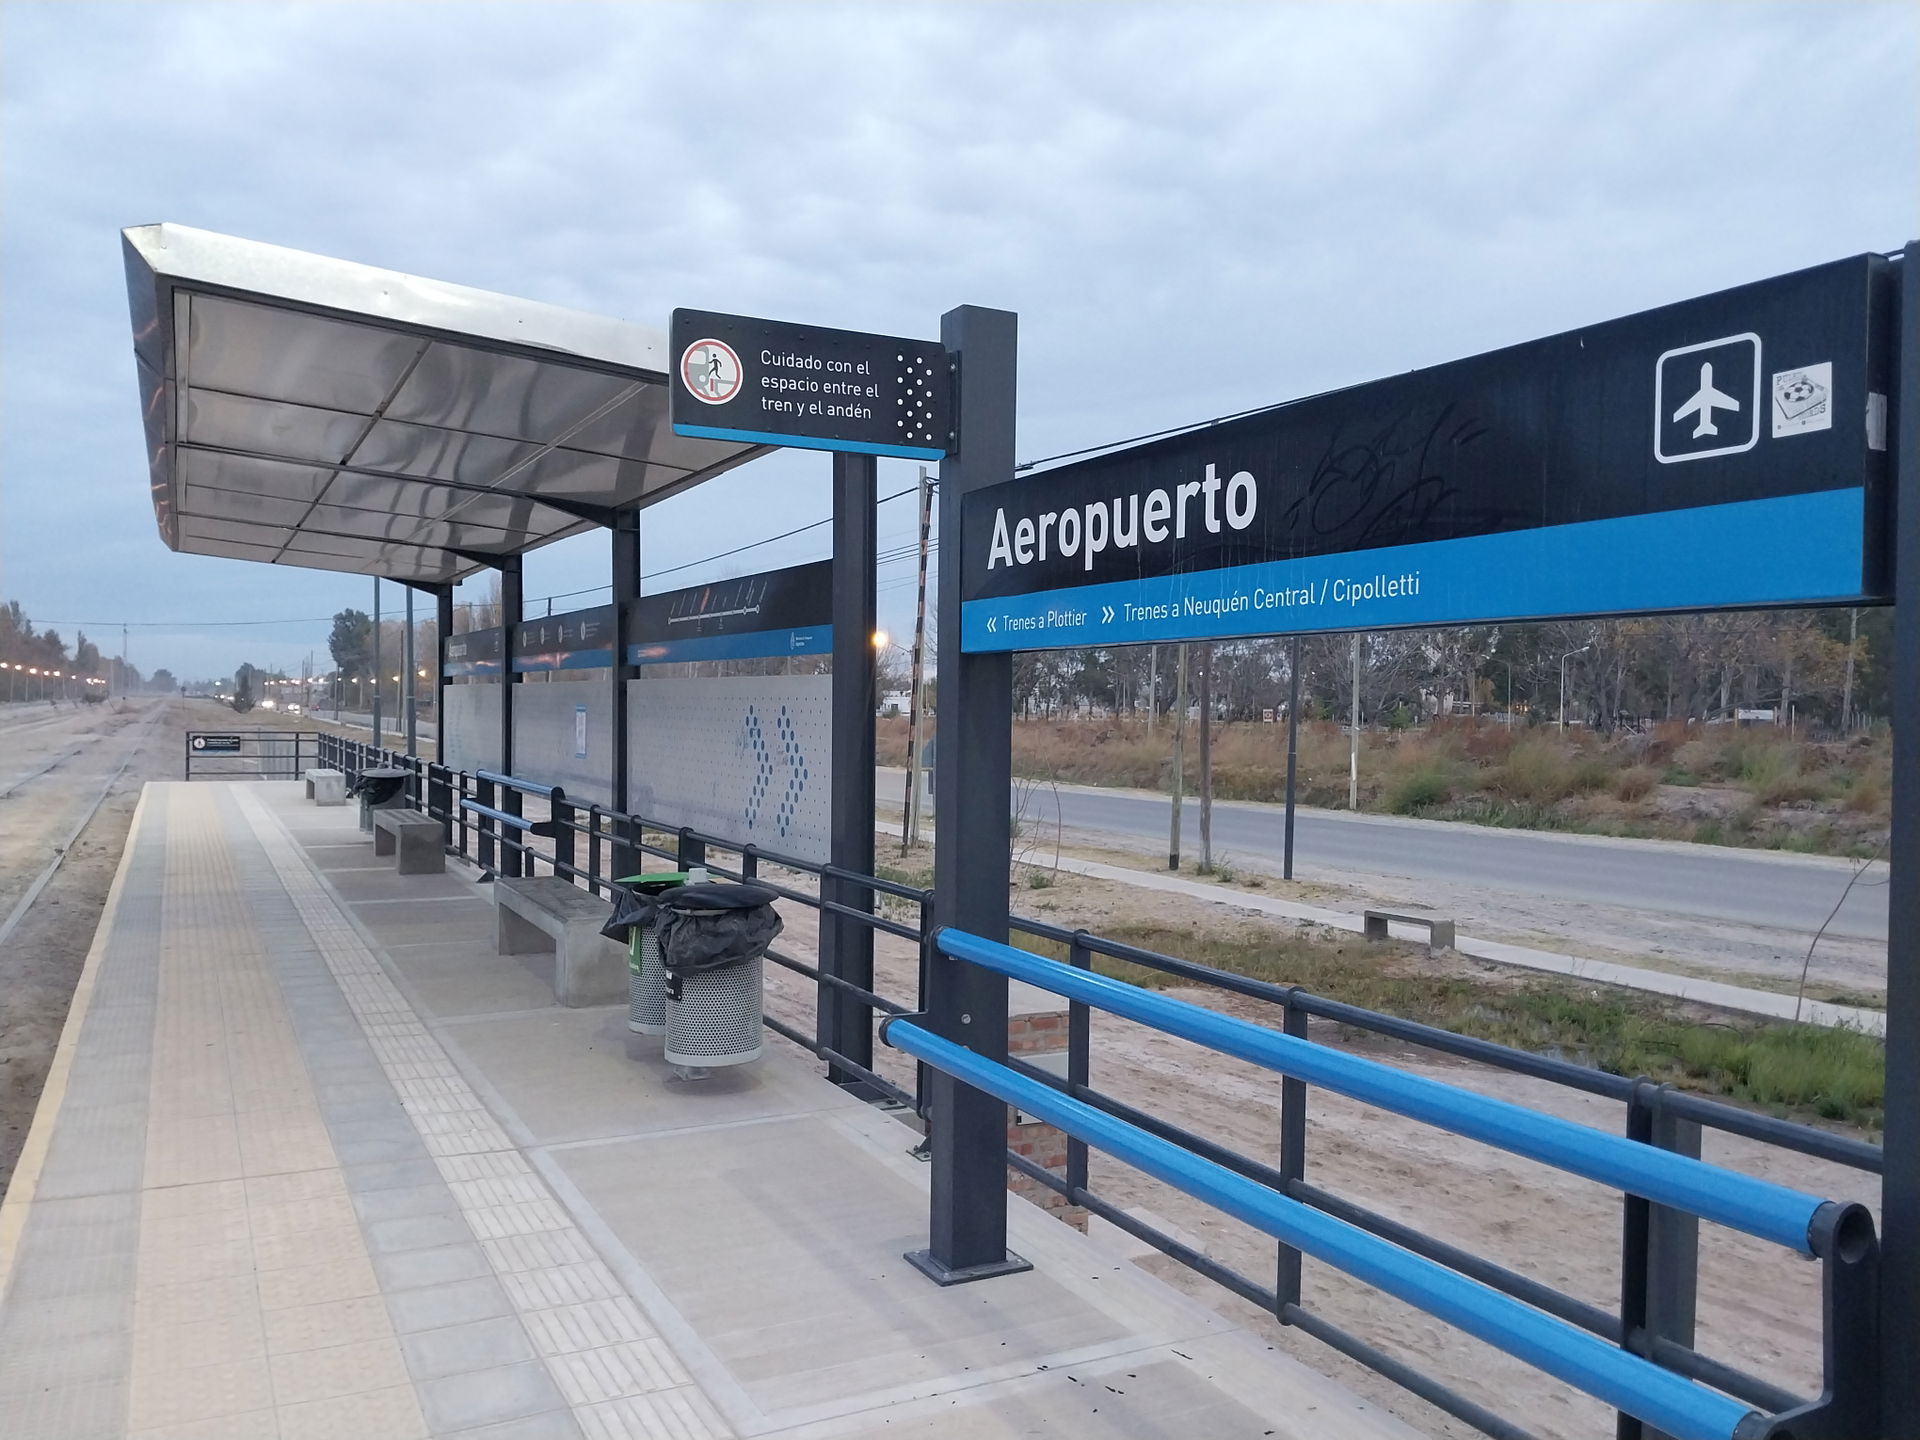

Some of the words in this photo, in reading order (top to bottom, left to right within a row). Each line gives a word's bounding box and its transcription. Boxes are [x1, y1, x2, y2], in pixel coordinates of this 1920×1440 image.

[761, 350, 822, 370] Cuidado
[826, 360, 852, 373] con
[856, 360, 870, 375] el
[761, 376, 819, 393] espacio
[823, 381, 861, 396] entre
[865, 383, 879, 398] el
[761, 396, 792, 412] tren
[796, 402, 805, 417] y
[809, 400, 823, 415] el
[827, 403, 871, 419] andén
[986, 462, 1258, 571] Aeropuerto
[1124, 603, 1168, 622] Trenes
[1171, 604, 1180, 617] a
[1184, 590, 1249, 619] Neuquén
[1254, 582, 1316, 610] Central
[1333, 570, 1420, 606] Cipolletti
[1003, 615, 1036, 632] Trenes
[1038, 616, 1045, 629] a
[1047, 610, 1088, 628] Plottier
